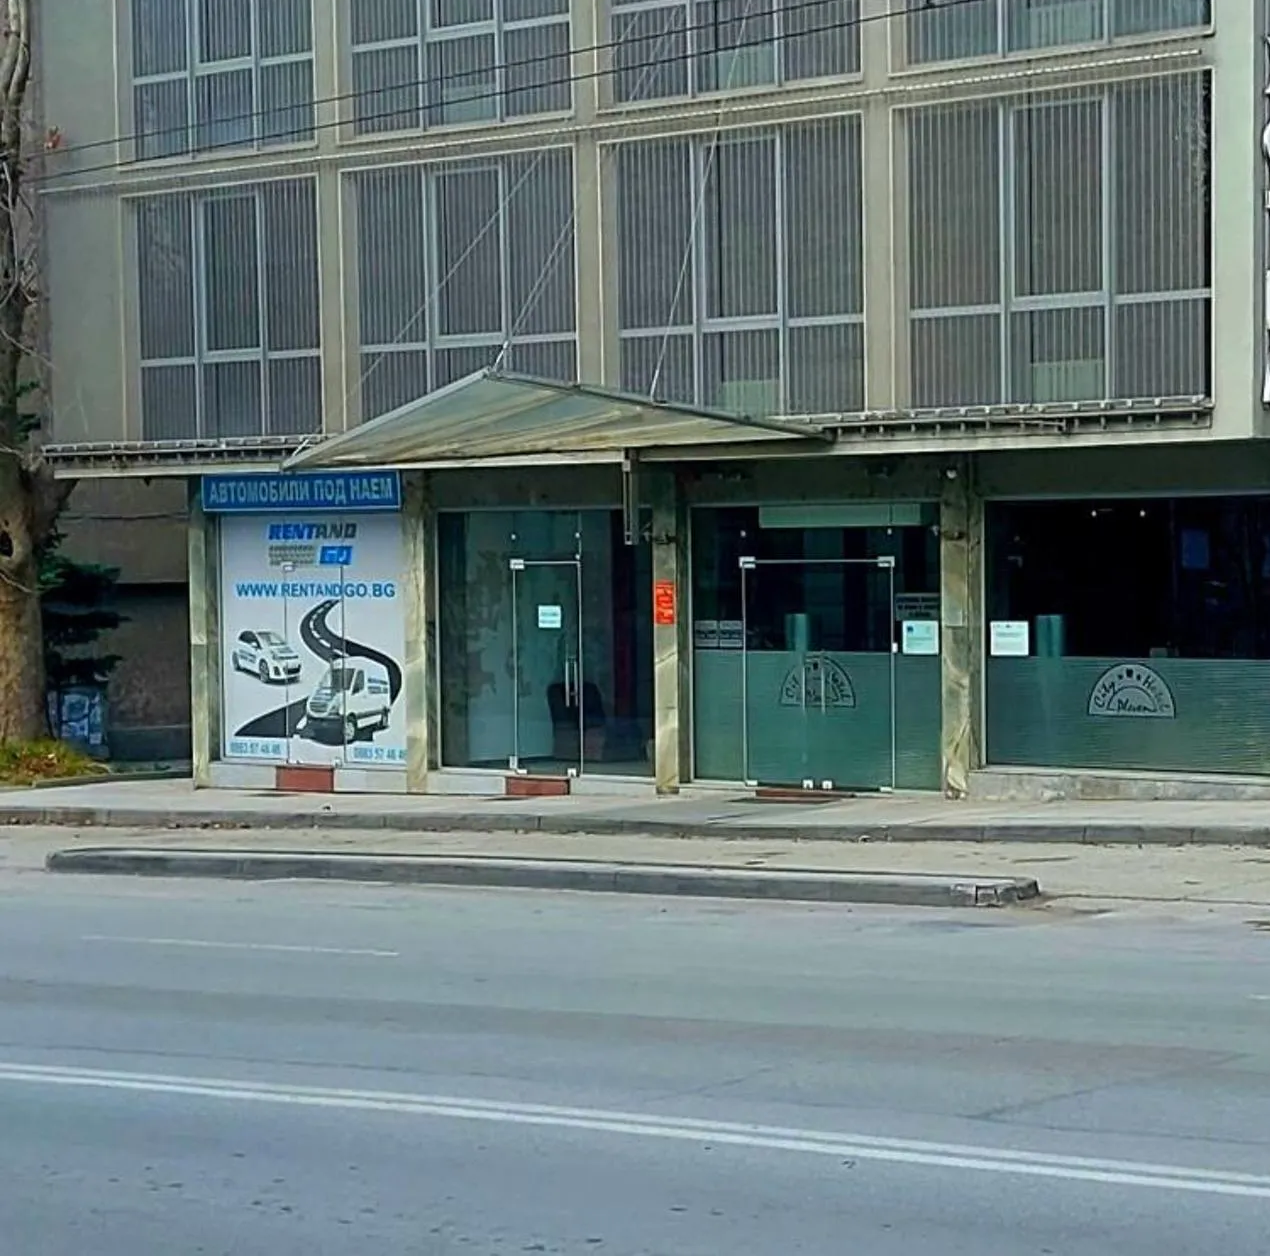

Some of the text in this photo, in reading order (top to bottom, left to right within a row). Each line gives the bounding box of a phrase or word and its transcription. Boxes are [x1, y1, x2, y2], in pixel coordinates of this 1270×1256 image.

[209, 477, 393, 505] АВТОМОБИЛИ ПОД НАЕМ
